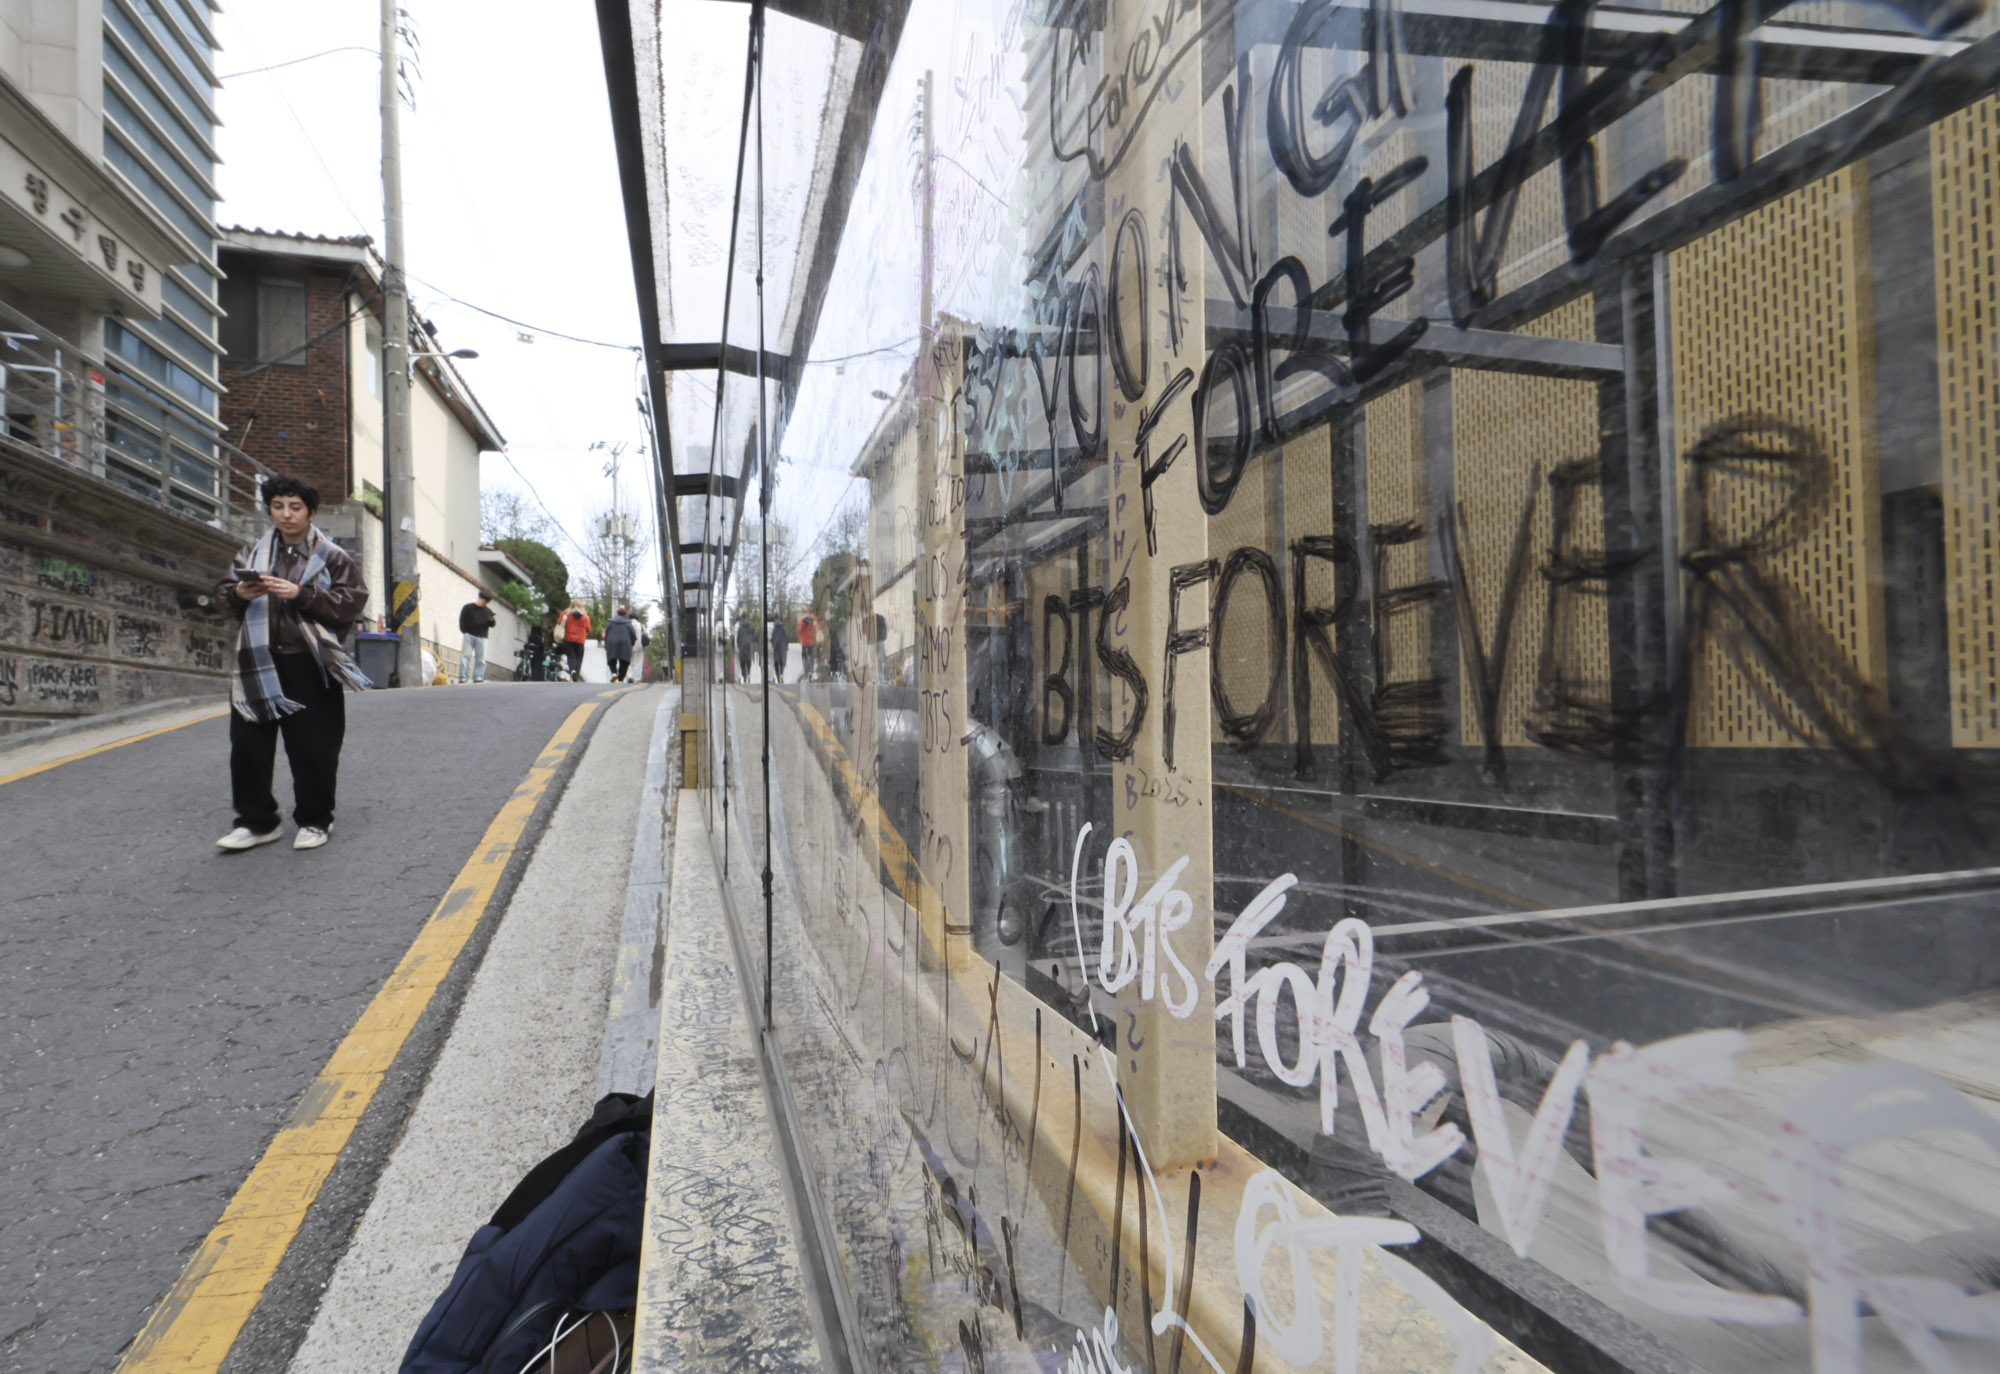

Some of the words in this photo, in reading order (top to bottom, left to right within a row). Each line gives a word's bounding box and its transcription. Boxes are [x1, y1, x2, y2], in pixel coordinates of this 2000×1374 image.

[30, 601, 110, 645] JIMIN
[1042, 577, 1149, 762] BTS
[1160, 412, 1925, 790] FOREVER
[33, 664, 66, 685] PARK
[921, 689, 952, 753] BTS
[1098, 837, 1199, 1019] BTS
[1205, 873, 2000, 1374] FOREVER
